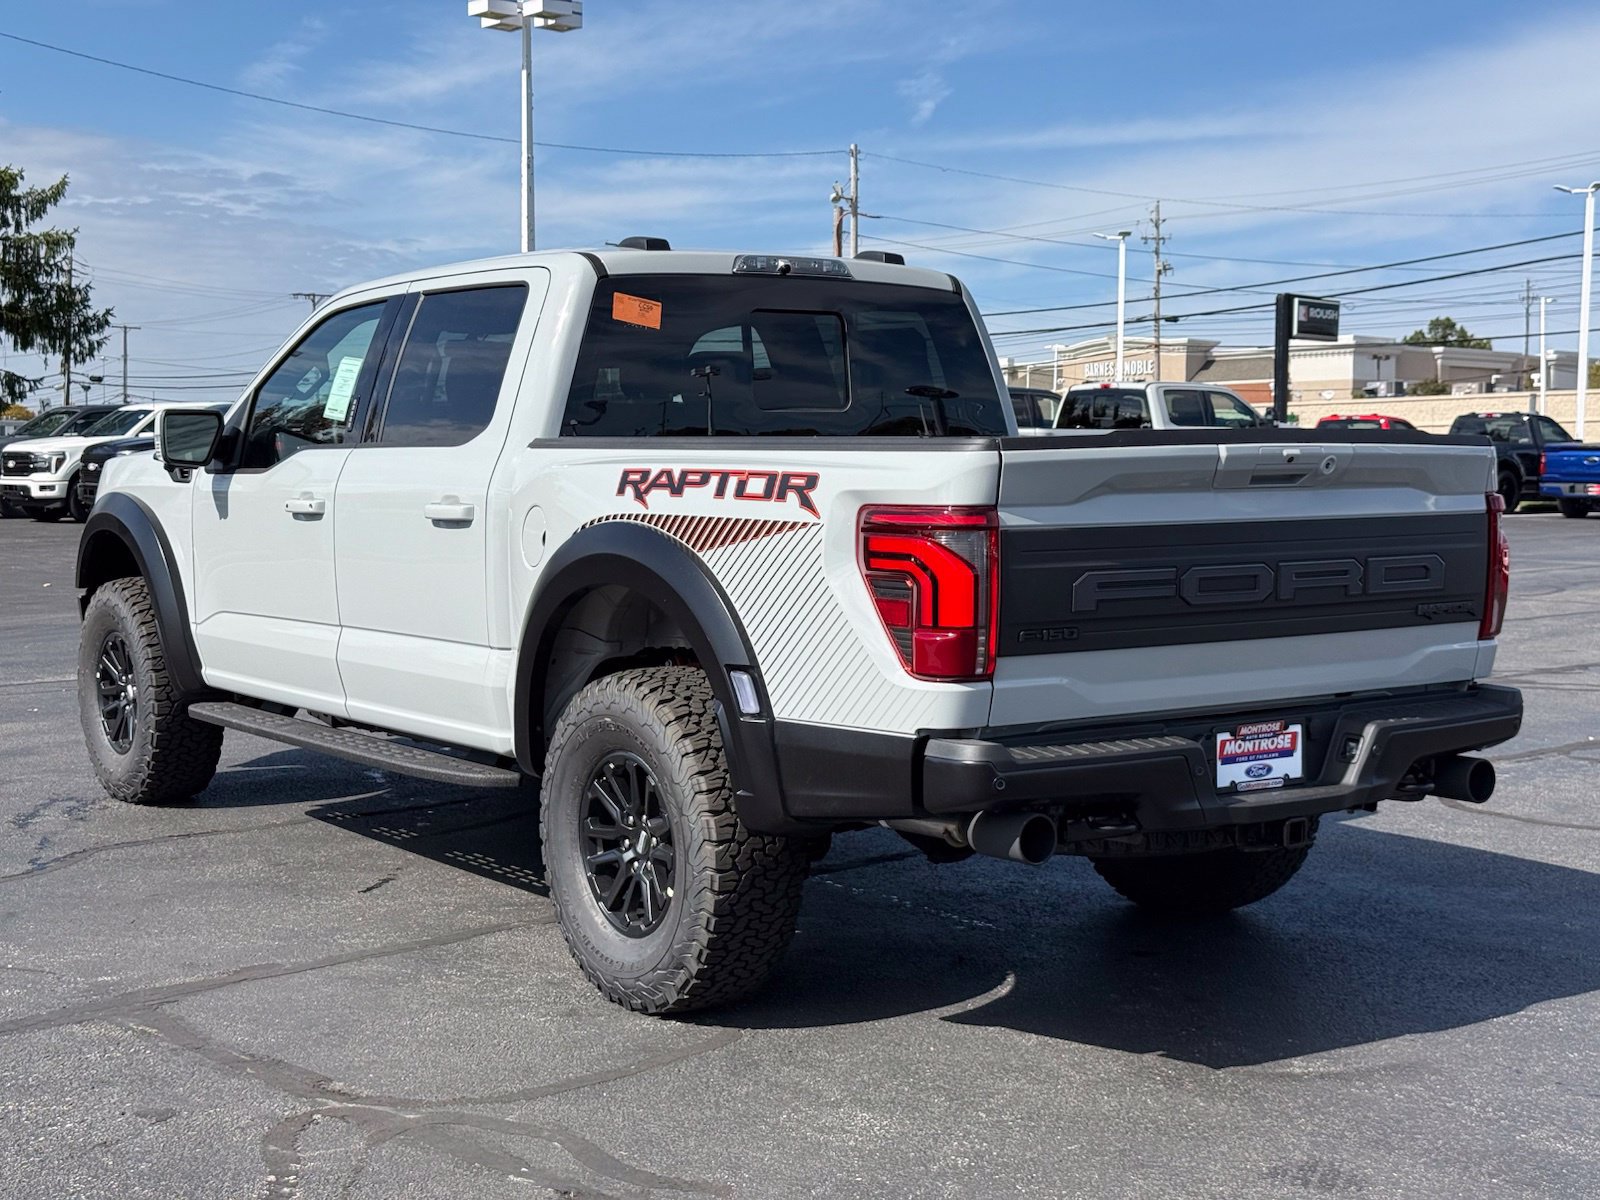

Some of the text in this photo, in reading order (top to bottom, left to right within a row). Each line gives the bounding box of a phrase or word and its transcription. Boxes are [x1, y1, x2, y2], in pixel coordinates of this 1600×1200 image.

[1309, 307, 1338, 320] ROUSH
[1085, 361, 1115, 377] BARNES
[1124, 360, 1154, 376] NOBLE
[616, 468, 821, 519] RAPTOR
[1072, 553, 1446, 612] FORD
[1017, 627, 1080, 643] F-150
[1240, 722, 1281, 735] MONTROSE
[1223, 734, 1292, 755] MONTROSE
[1250, 766, 1269, 777] Ford
